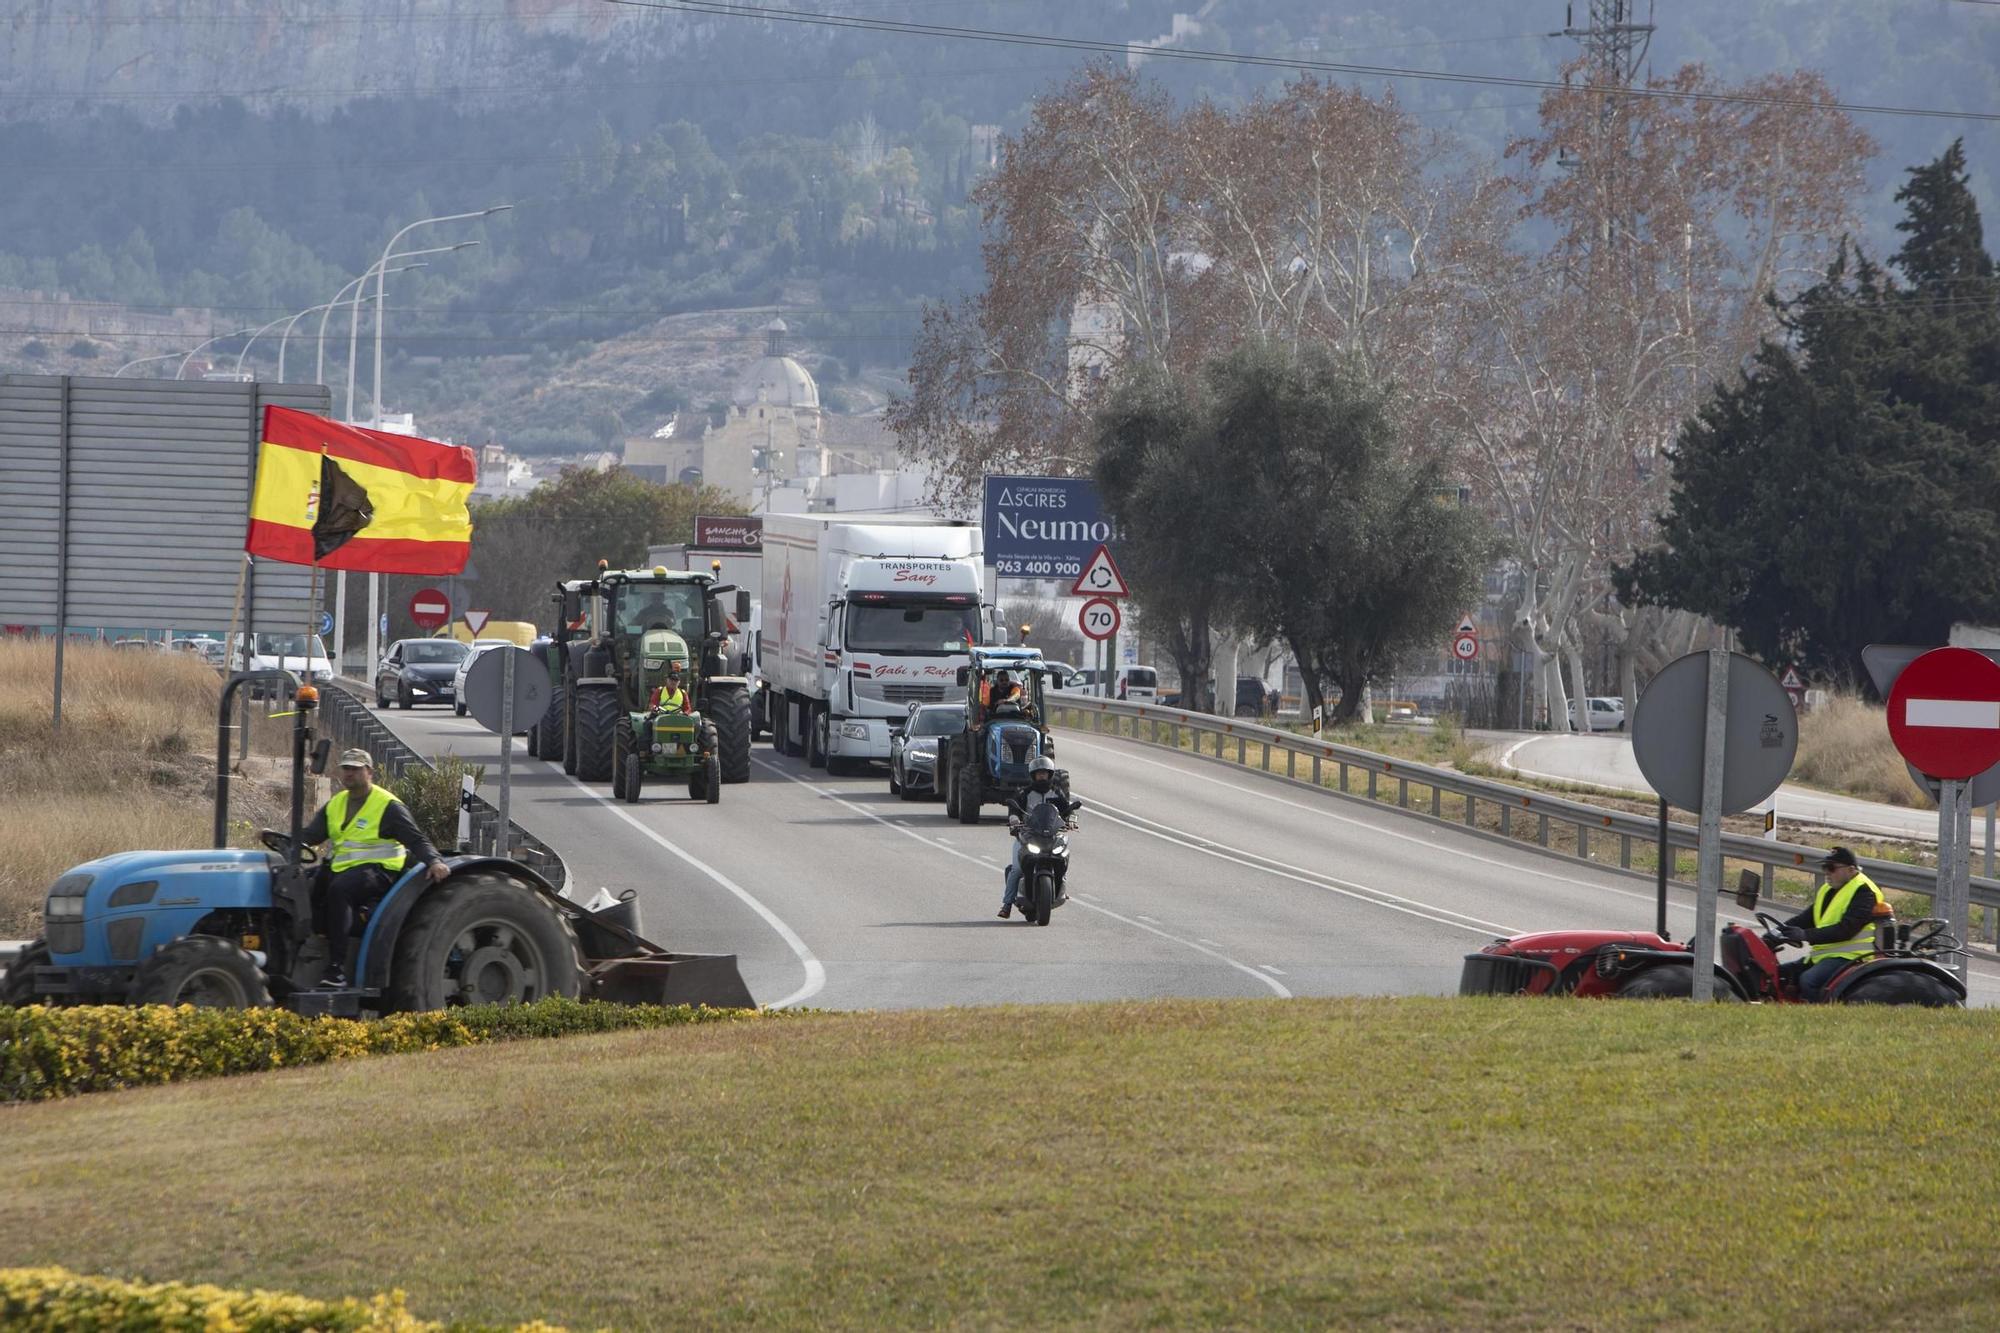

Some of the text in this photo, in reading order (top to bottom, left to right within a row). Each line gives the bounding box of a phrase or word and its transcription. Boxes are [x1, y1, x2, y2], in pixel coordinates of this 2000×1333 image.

[998, 487, 1067, 508] ASCIRES
[996, 511, 1117, 542] Neumo
[879, 562, 952, 571] TRANSPORTES
[996, 560, 1081, 575] 963 400 900
[893, 570, 938, 586] Sanz
[1088, 612, 1112, 627] 70
[1459, 642, 1473, 652] 40
[874, 664, 907, 678] Gabi
[924, 665, 956, 678] Rafa
